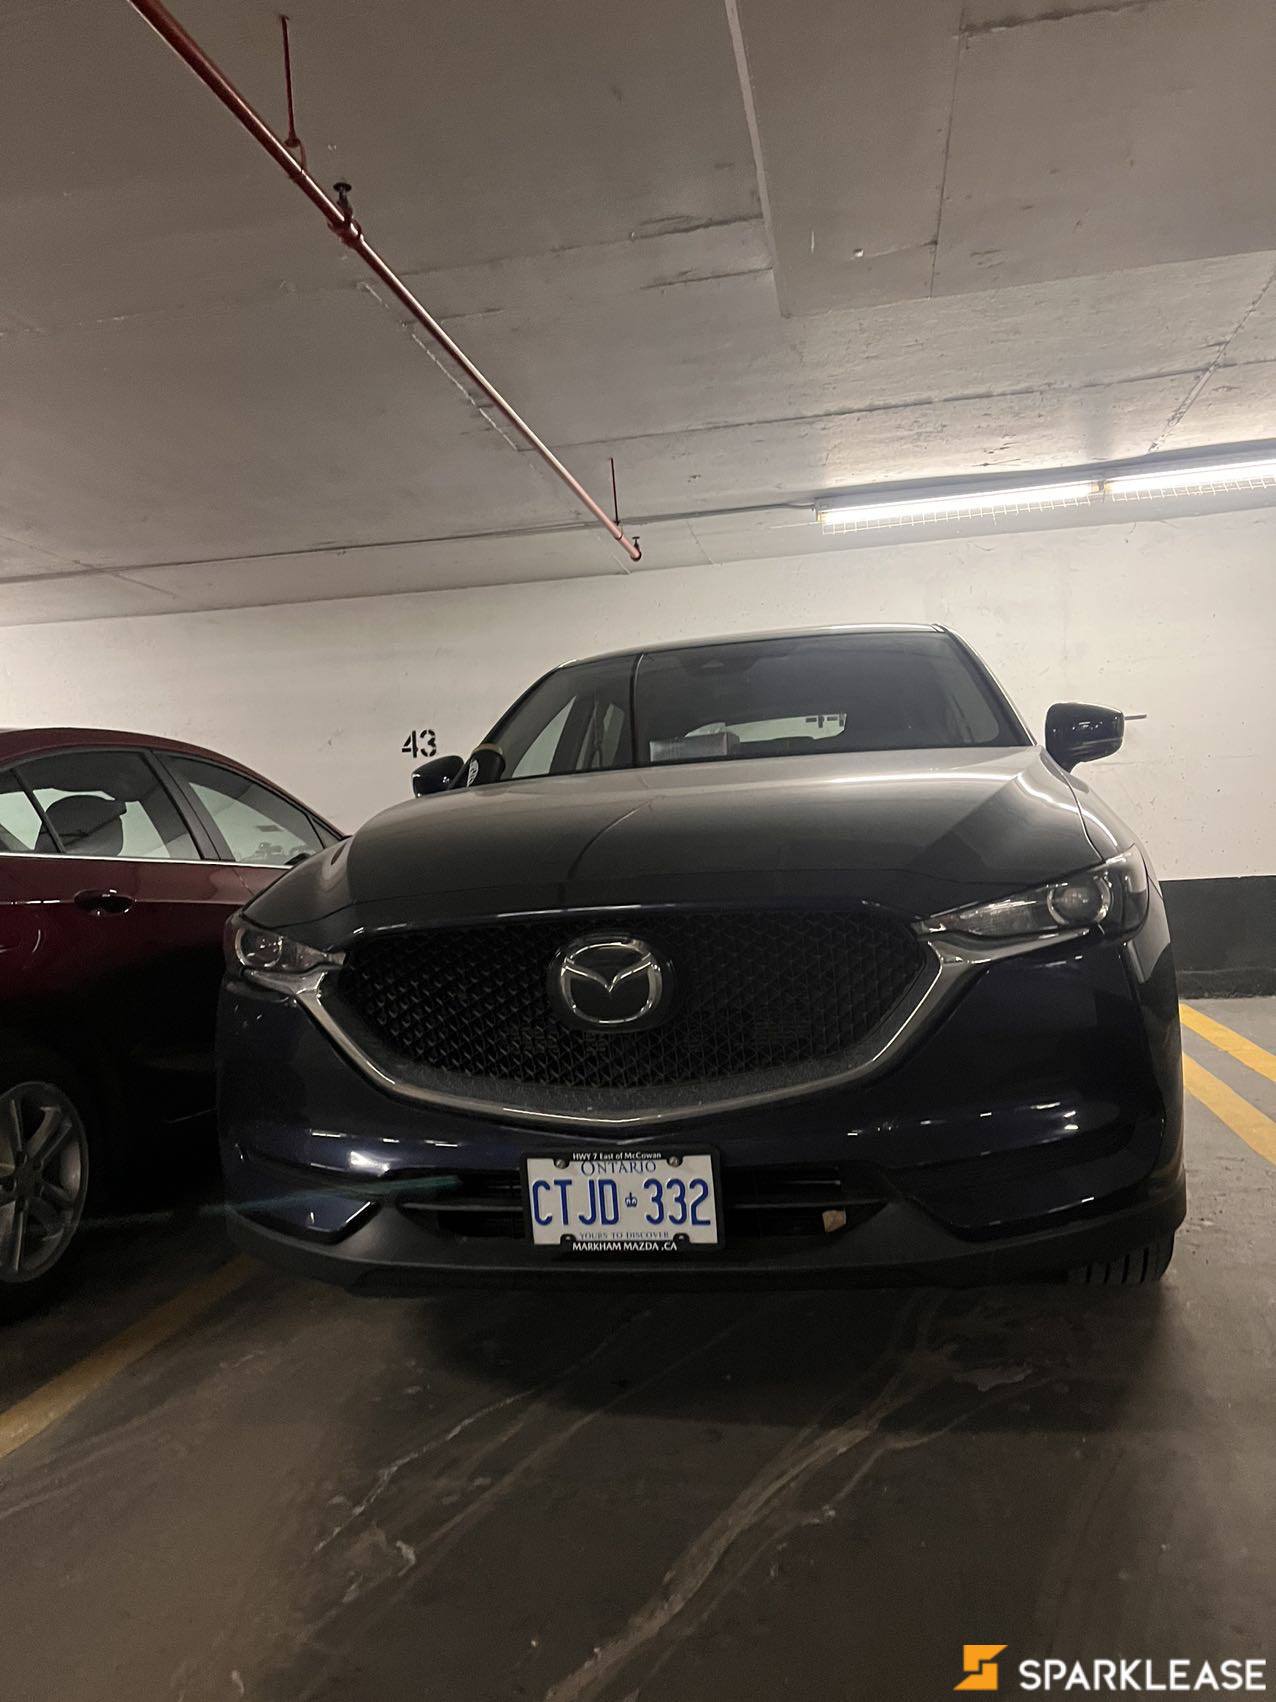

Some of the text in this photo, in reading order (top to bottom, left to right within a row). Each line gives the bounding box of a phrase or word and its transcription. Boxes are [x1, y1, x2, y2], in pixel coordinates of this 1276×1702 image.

[402, 729, 437, 758] 43
[572, 1152, 591, 1160] HWY
[615, 1152, 623, 1160] of
[624, 1151, 662, 1160] McCowan
[581, 1161, 656, 1176] ONTARIO
[532, 1178, 711, 1226] CTJD 332
[580, 1232, 608, 1240] YOURS
[626, 1231, 669, 1239] DISCOVER
[572, 1242, 622, 1251] MARKHAM
